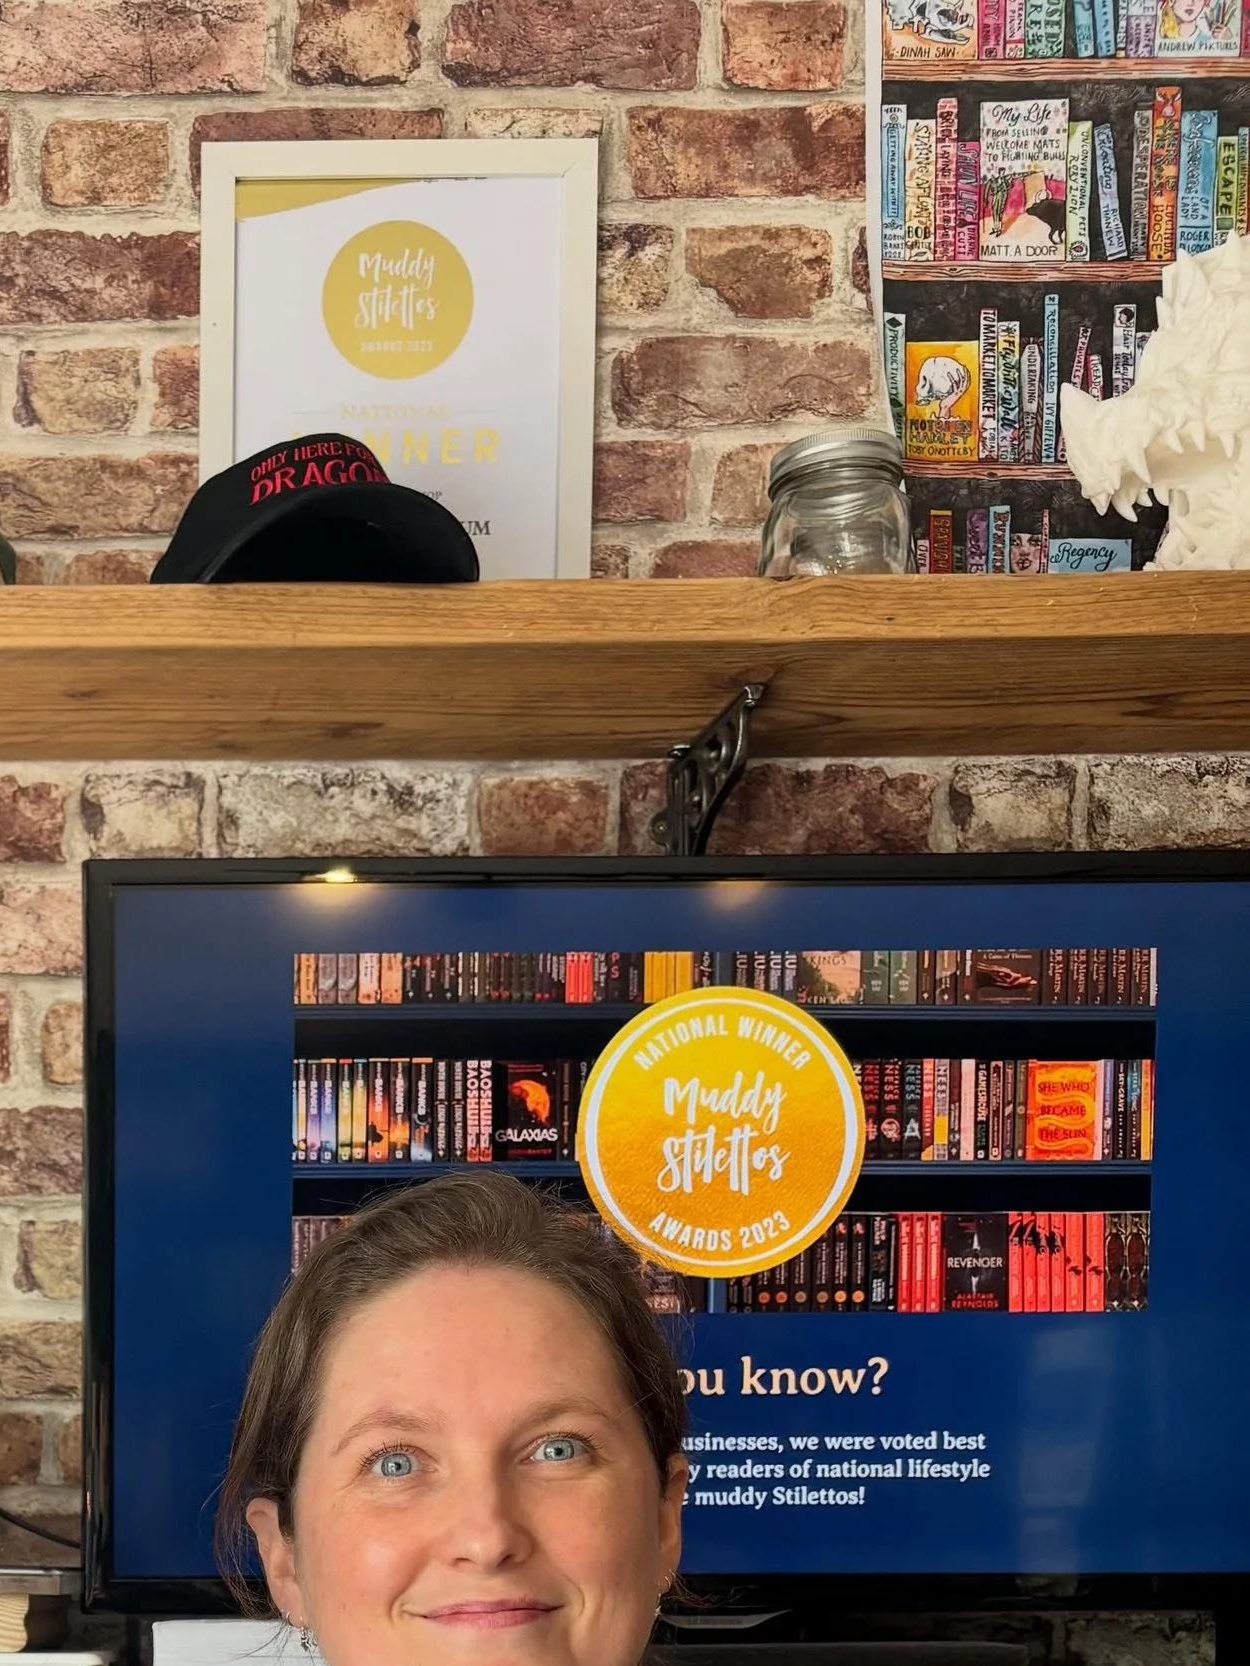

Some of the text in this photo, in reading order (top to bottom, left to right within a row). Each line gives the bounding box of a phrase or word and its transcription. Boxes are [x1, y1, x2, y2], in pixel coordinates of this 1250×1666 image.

[900, 47, 955, 57] DINAH SAW
[992, 103, 1051, 126] My Life
[986, 126, 1049, 137] FROM SELLING
[986, 139, 1060, 149] WELCOME MATS
[915, 122, 931, 173] STAYING
[986, 150, 1065, 162] TO FIGHTING BULLS
[1069, 156, 1079, 187] RORY
[1078, 132, 1089, 237] UNCONVENTIONAL PETS
[1133, 128, 1150, 220] DESPERATION
[1220, 142, 1234, 215] ESCAPE
[1180, 197, 1189, 220] LADY
[1189, 197, 1199, 220] LAND
[1199, 198, 1209, 211] OF
[907, 226, 930, 240] BOB
[1103, 204, 1115, 246] THANEW
[1112, 208, 1124, 248] RICHARD
[1152, 205, 1164, 253] HOOSE
[1164, 204, 1174, 254] LUCINDA
[1180, 231, 1210, 241] ROGER
[1014, 245, 1022, 256] A
[1026, 245, 1058, 256] DOOR
[358, 248, 437, 288] Muddy
[354, 284, 440, 330] Stilettos
[890, 329, 899, 395] PRODUCTIVITY
[1027, 345, 1038, 404] UNDERTAKING
[340, 406, 448, 420] NATIONAL
[1046, 403, 1056, 417] IVY
[251, 442, 378, 481] ONLY HERE FOR
[1051, 542, 1117, 572] Regency
[633, 1014, 812, 1070] NATIONAL WINNER
[664, 1071, 788, 1134] Muddy
[495, 1128, 558, 1142] GALAXIAS
[656, 1124, 791, 1196] Stilettos
[648, 1210, 791, 1251] AWARDS 2023
[947, 1256, 1003, 1268] REVENGER
[676, 1356, 890, 1395] ou know?
[682, 1431, 986, 1453] usinesses, we were voted best
[706, 1459, 784, 1478] readers
[789, 1458, 814, 1478] of
[816, 1459, 902, 1478] national
[908, 1459, 991, 1482] lifestyle
[695, 1487, 865, 1510] muddy Stilettos!
